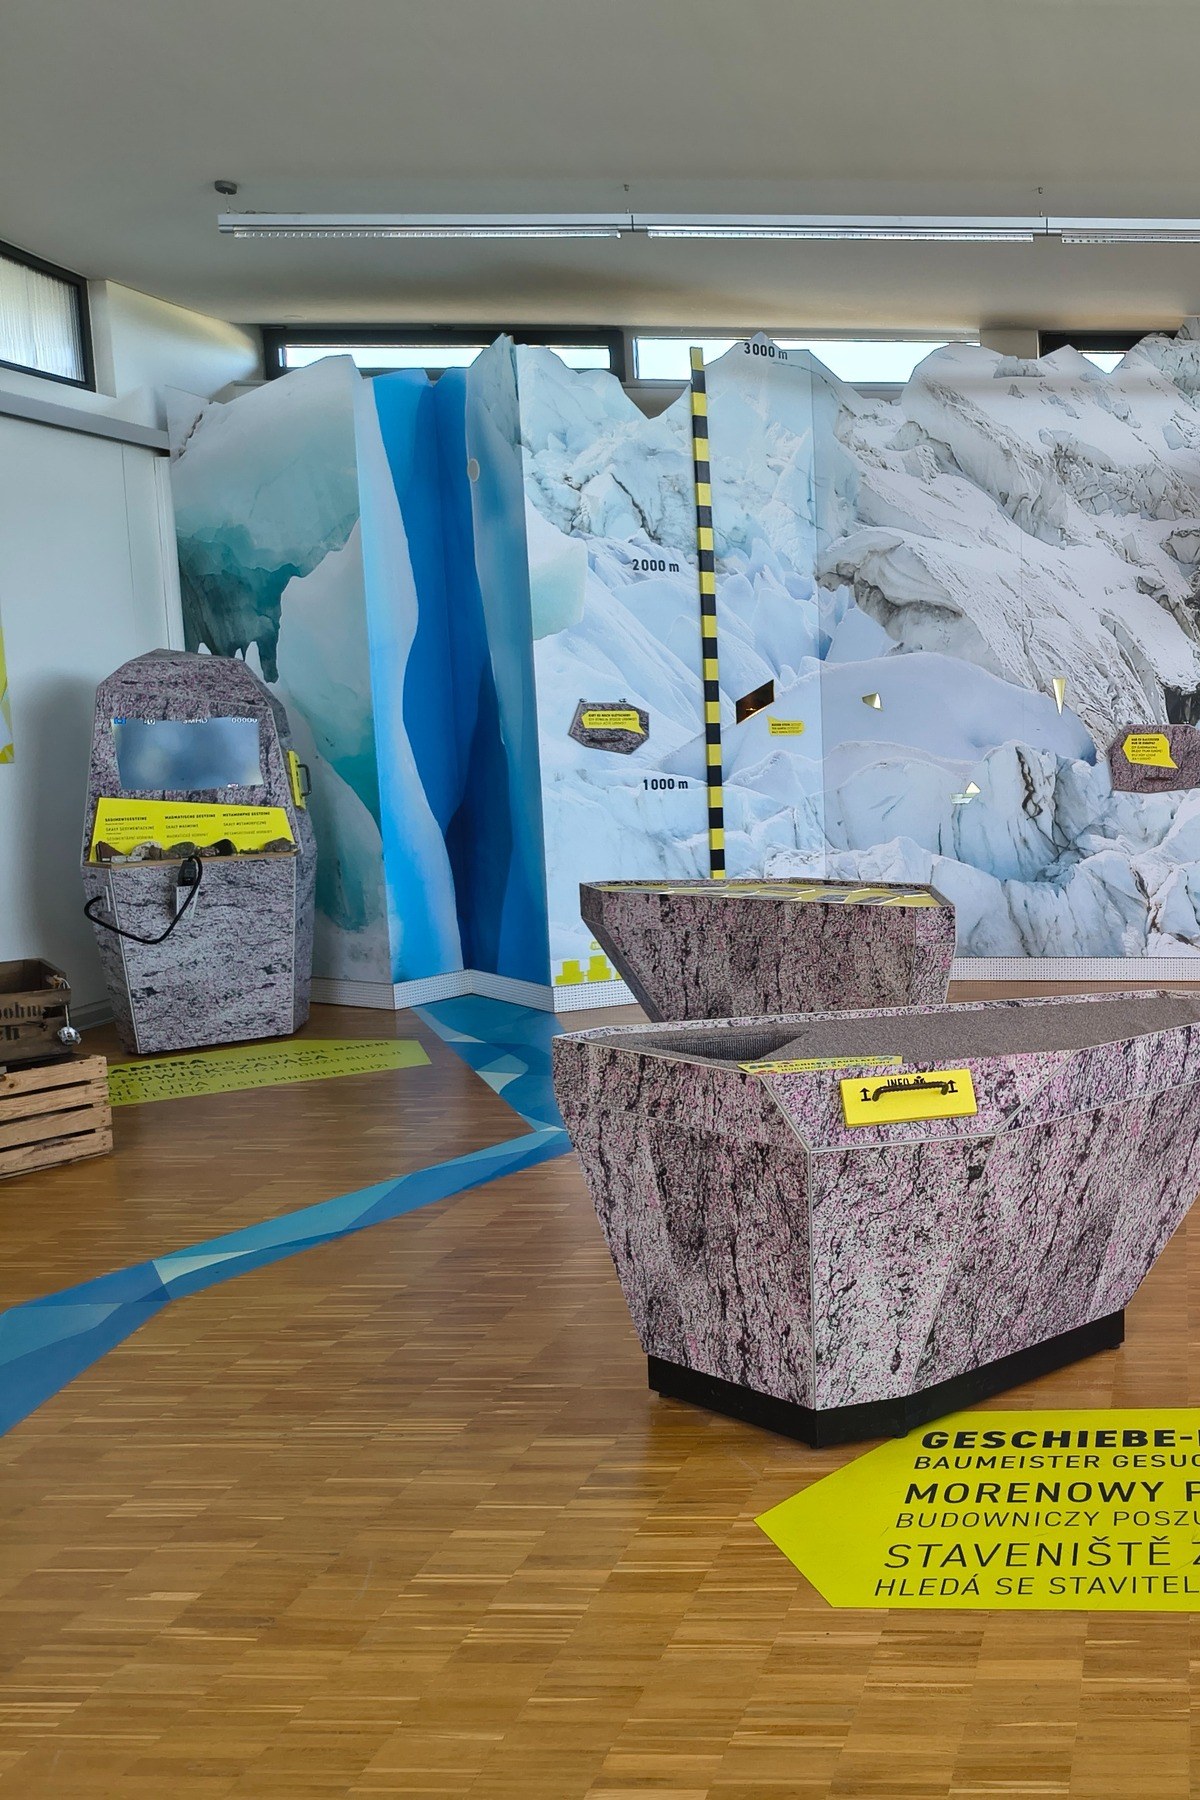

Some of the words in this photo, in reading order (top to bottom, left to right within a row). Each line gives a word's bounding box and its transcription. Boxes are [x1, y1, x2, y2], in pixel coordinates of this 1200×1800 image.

[744, 342, 775, 358] 3000
[778, 350, 788, 360] m
[632, 558, 666, 572] 2000
[669, 563, 680, 572] m
[643, 778, 675, 790] 1000
[678, 780, 689, 789] m
[111, 1059, 206, 1074] AMERA
[144, 1081, 208, 1093] LUPA
[913, 1454, 1101, 1470] BAUMEISTER
[904, 1481, 1165, 1504] MORENOWY
[895, 1511, 1100, 1529] BUDOWNICZY
[883, 1535, 1171, 1569] STAVENIŠTĚ
[873, 1573, 980, 1597] HLEDÁ
[995, 1577, 1035, 1596] SE
